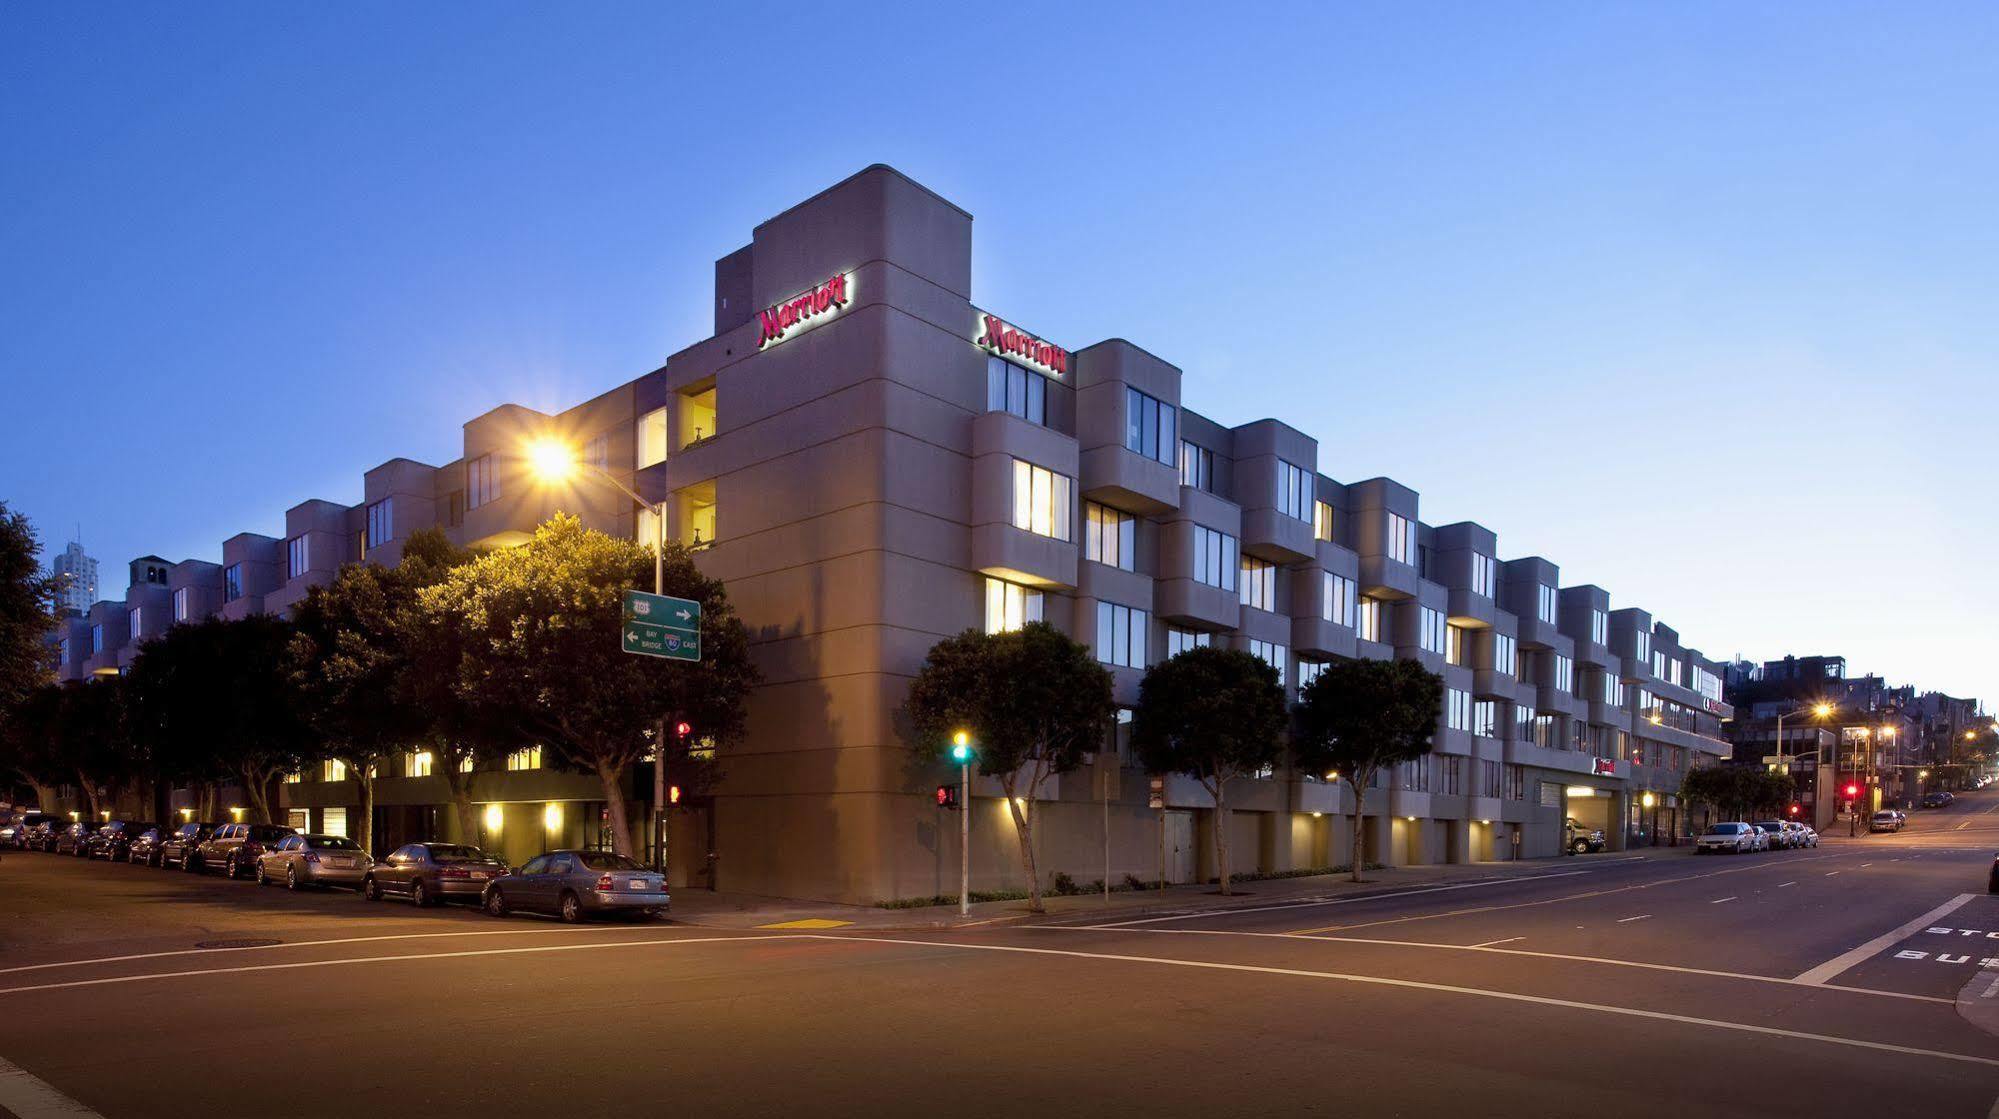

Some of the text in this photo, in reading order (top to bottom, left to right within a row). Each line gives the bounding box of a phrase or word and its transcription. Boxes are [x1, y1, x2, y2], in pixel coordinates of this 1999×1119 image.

[757, 273, 847, 347] Marriott
[978, 314, 1066, 374] Marriott
[642, 639, 697, 649] BRIDGE 80 EAST
[646, 630, 658, 638] BAY
